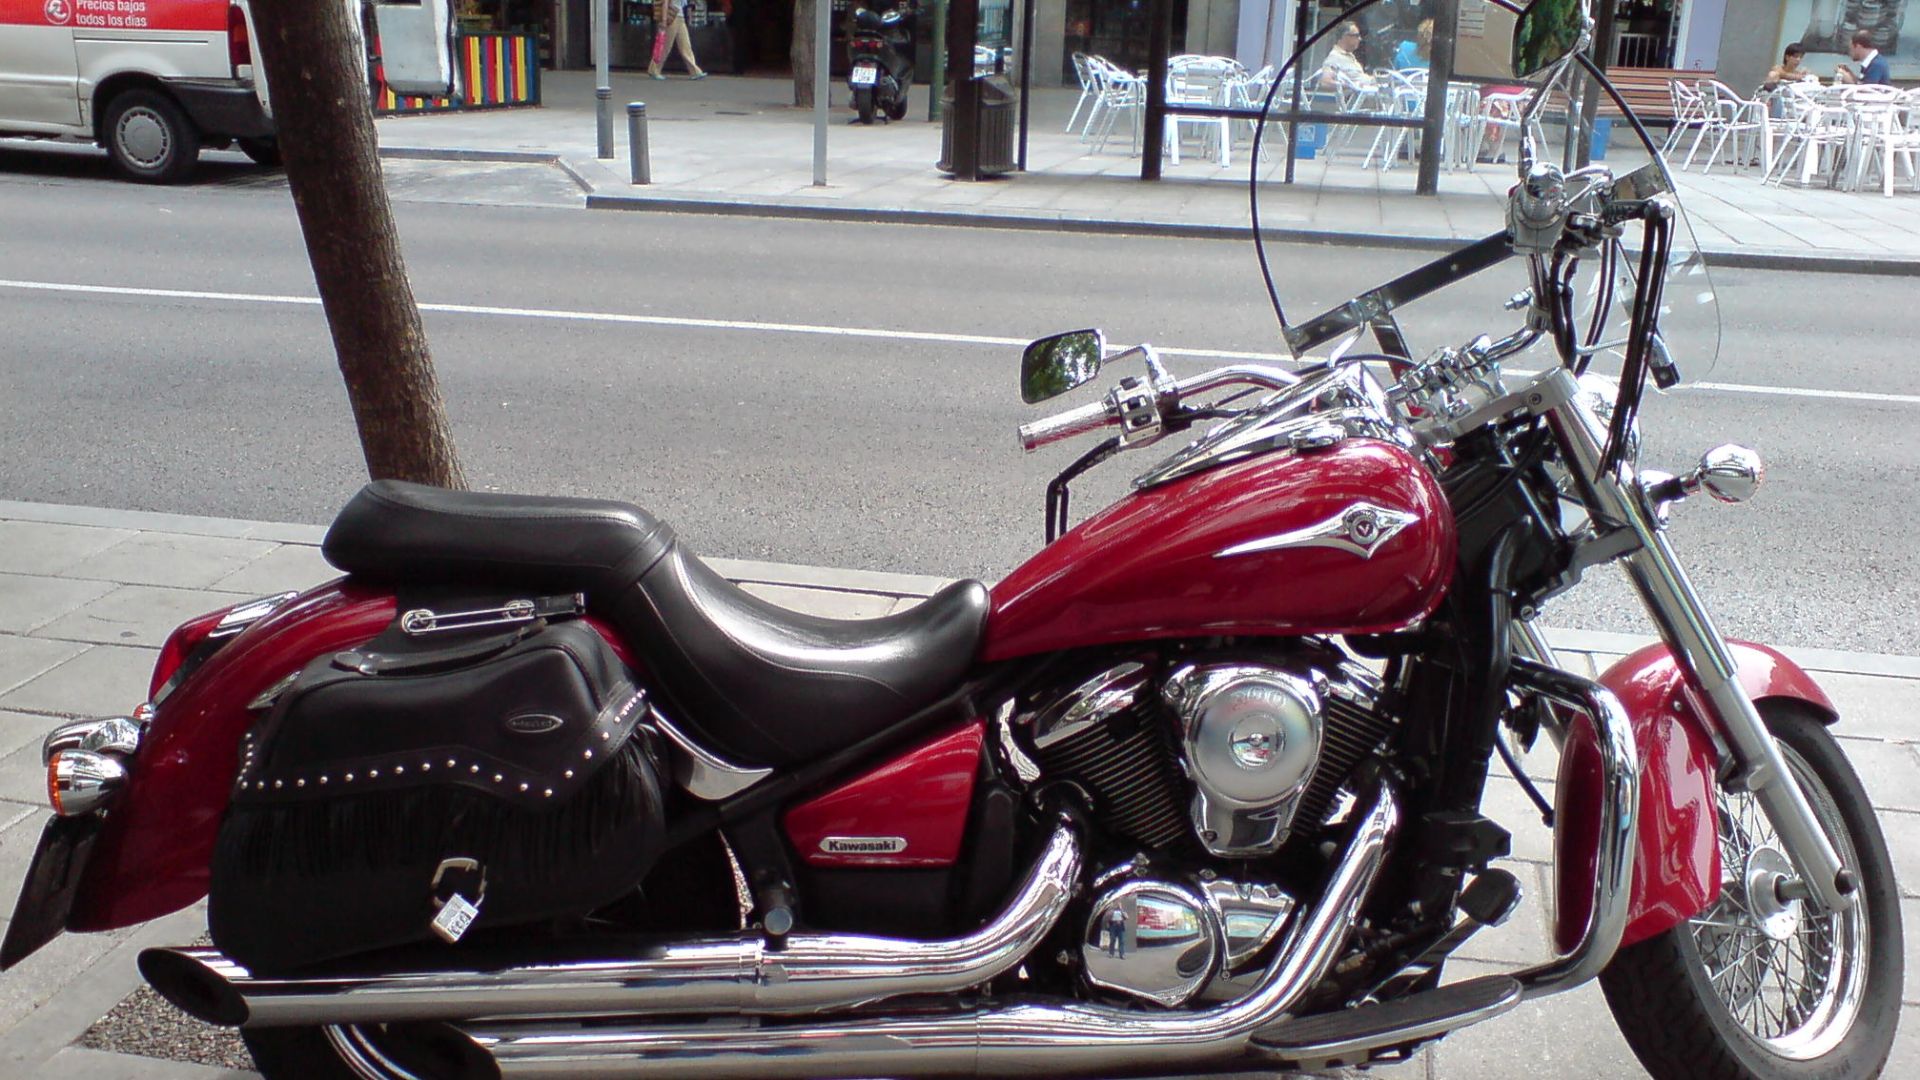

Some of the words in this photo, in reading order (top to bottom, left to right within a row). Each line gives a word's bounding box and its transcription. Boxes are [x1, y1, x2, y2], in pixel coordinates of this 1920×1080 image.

[76, 0, 115, 11] Precios
[117, 0, 145, 13] bajos
[75, 13, 105, 25] todos
[107, 14, 123, 25] los
[828, 841, 897, 851] Kawasaki
